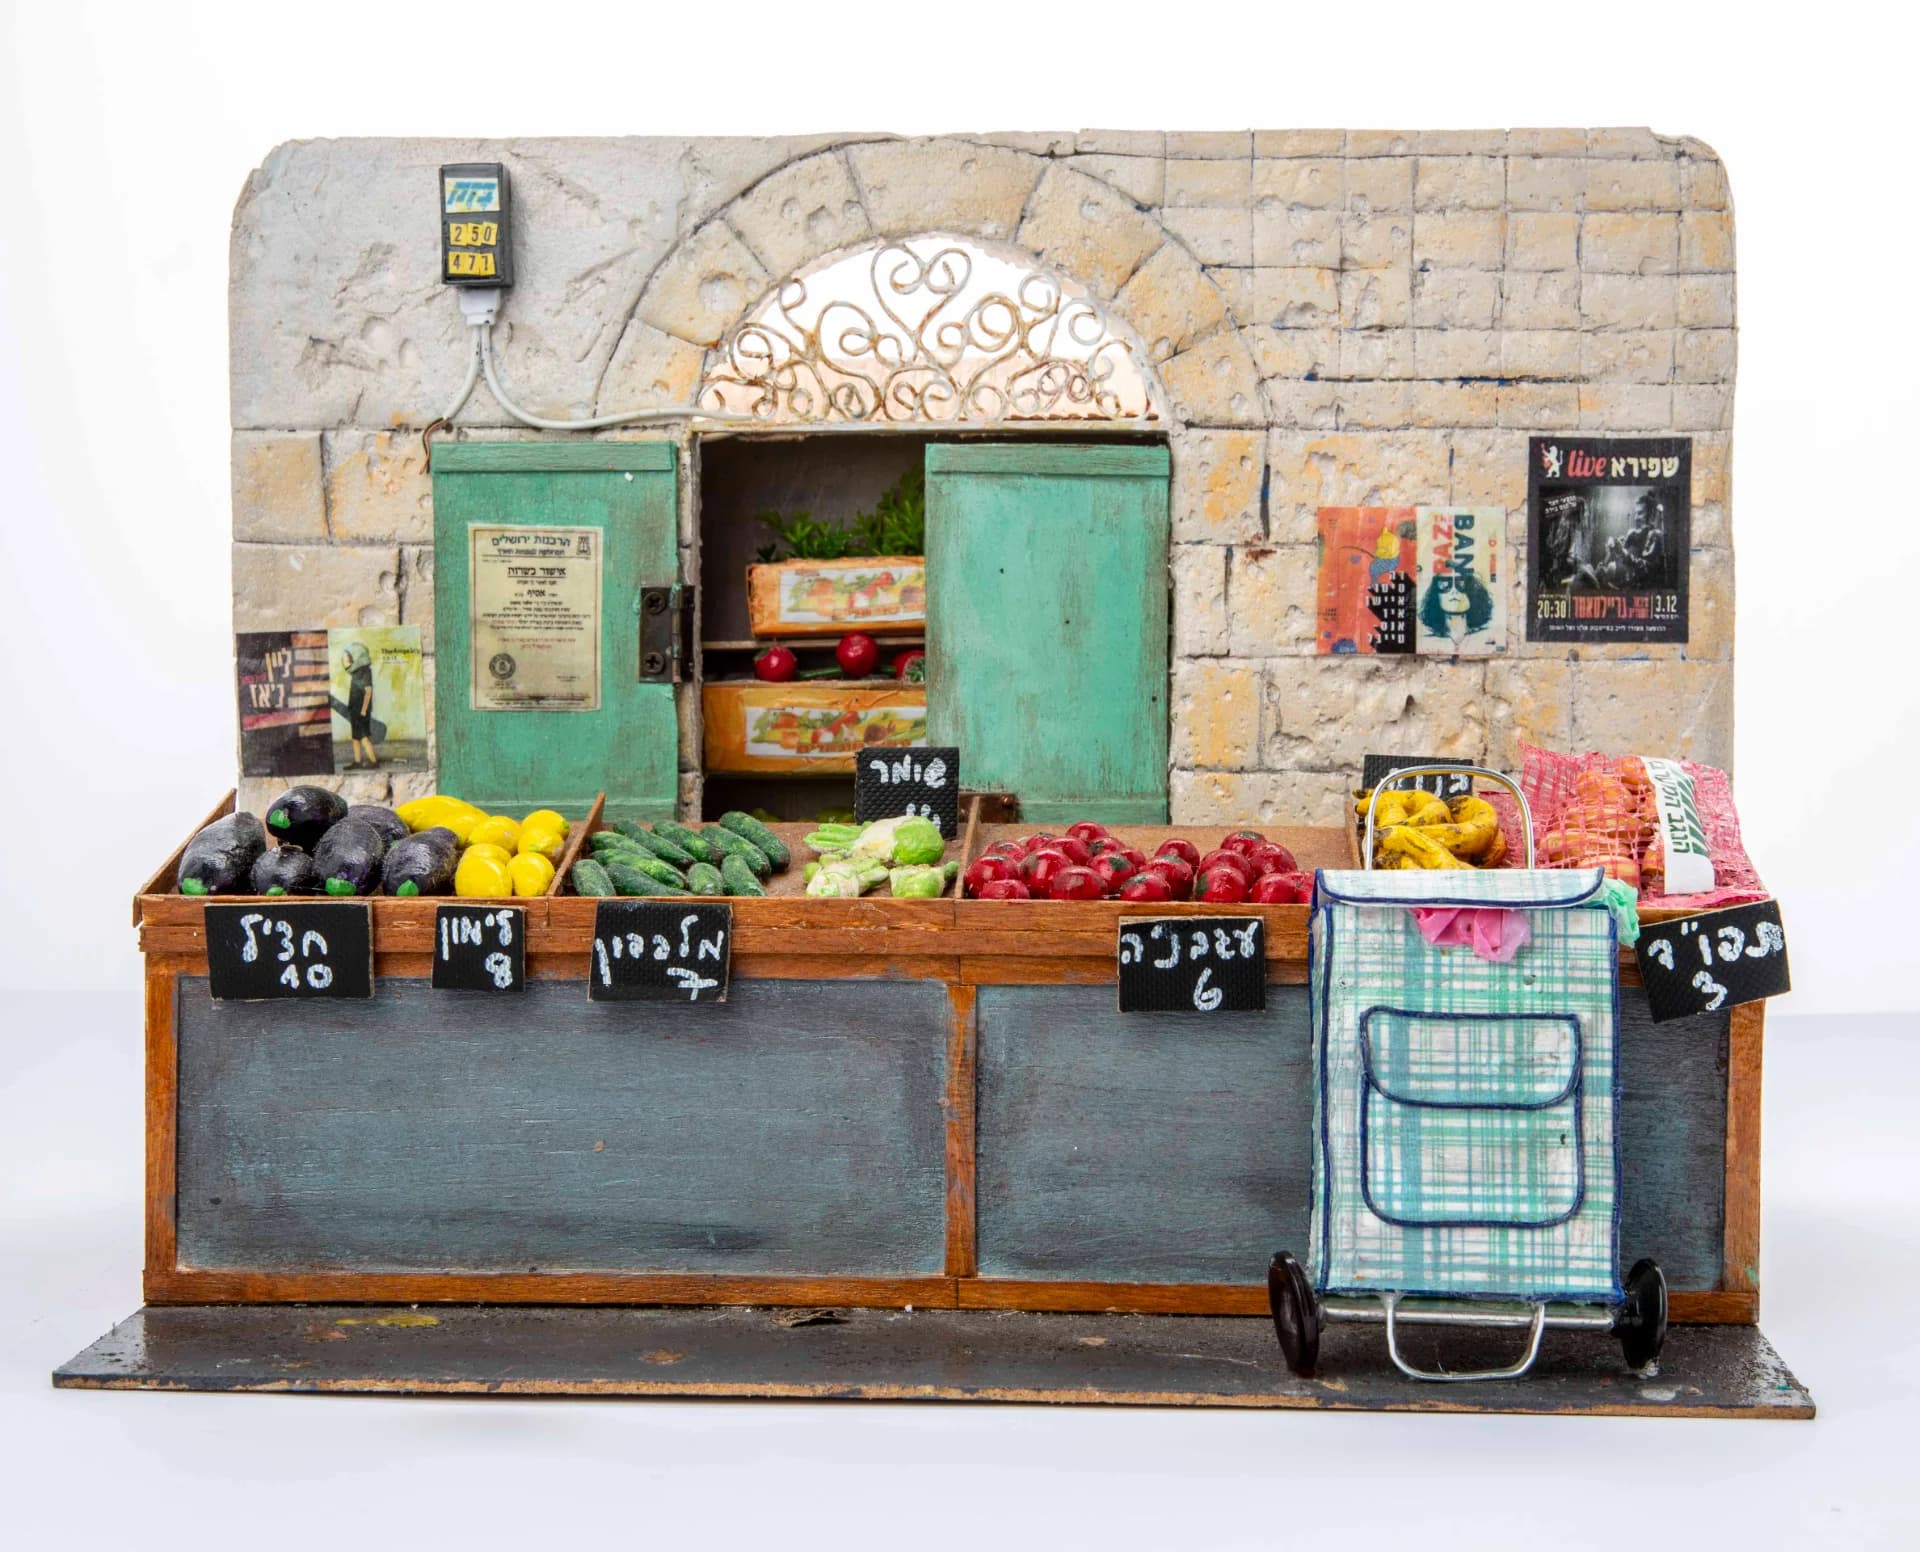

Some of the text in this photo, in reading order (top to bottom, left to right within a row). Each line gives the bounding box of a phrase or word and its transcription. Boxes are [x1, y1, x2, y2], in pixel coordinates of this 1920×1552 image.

[454, 225, 492, 242] 250
[1566, 449, 1680, 479] שפירא live
[491, 533, 571, 547] הרבנות ירושלים
[507, 567, 567, 576] אישור כשרות
[1537, 600, 1567, 619] 20:30
[1655, 594, 1678, 613] 3.12
[869, 753, 947, 789] שומר
[1667, 812, 1692, 855] הנגב
[240, 913, 328, 963] חציל
[439, 909, 514, 961] לימון
[594, 914, 725, 985] מלפפון
[1120, 920, 1259, 969] עגבניה
[280, 963, 334, 990] 10
[1193, 967, 1223, 1011] 6
[1692, 970, 1729, 1011] 3
